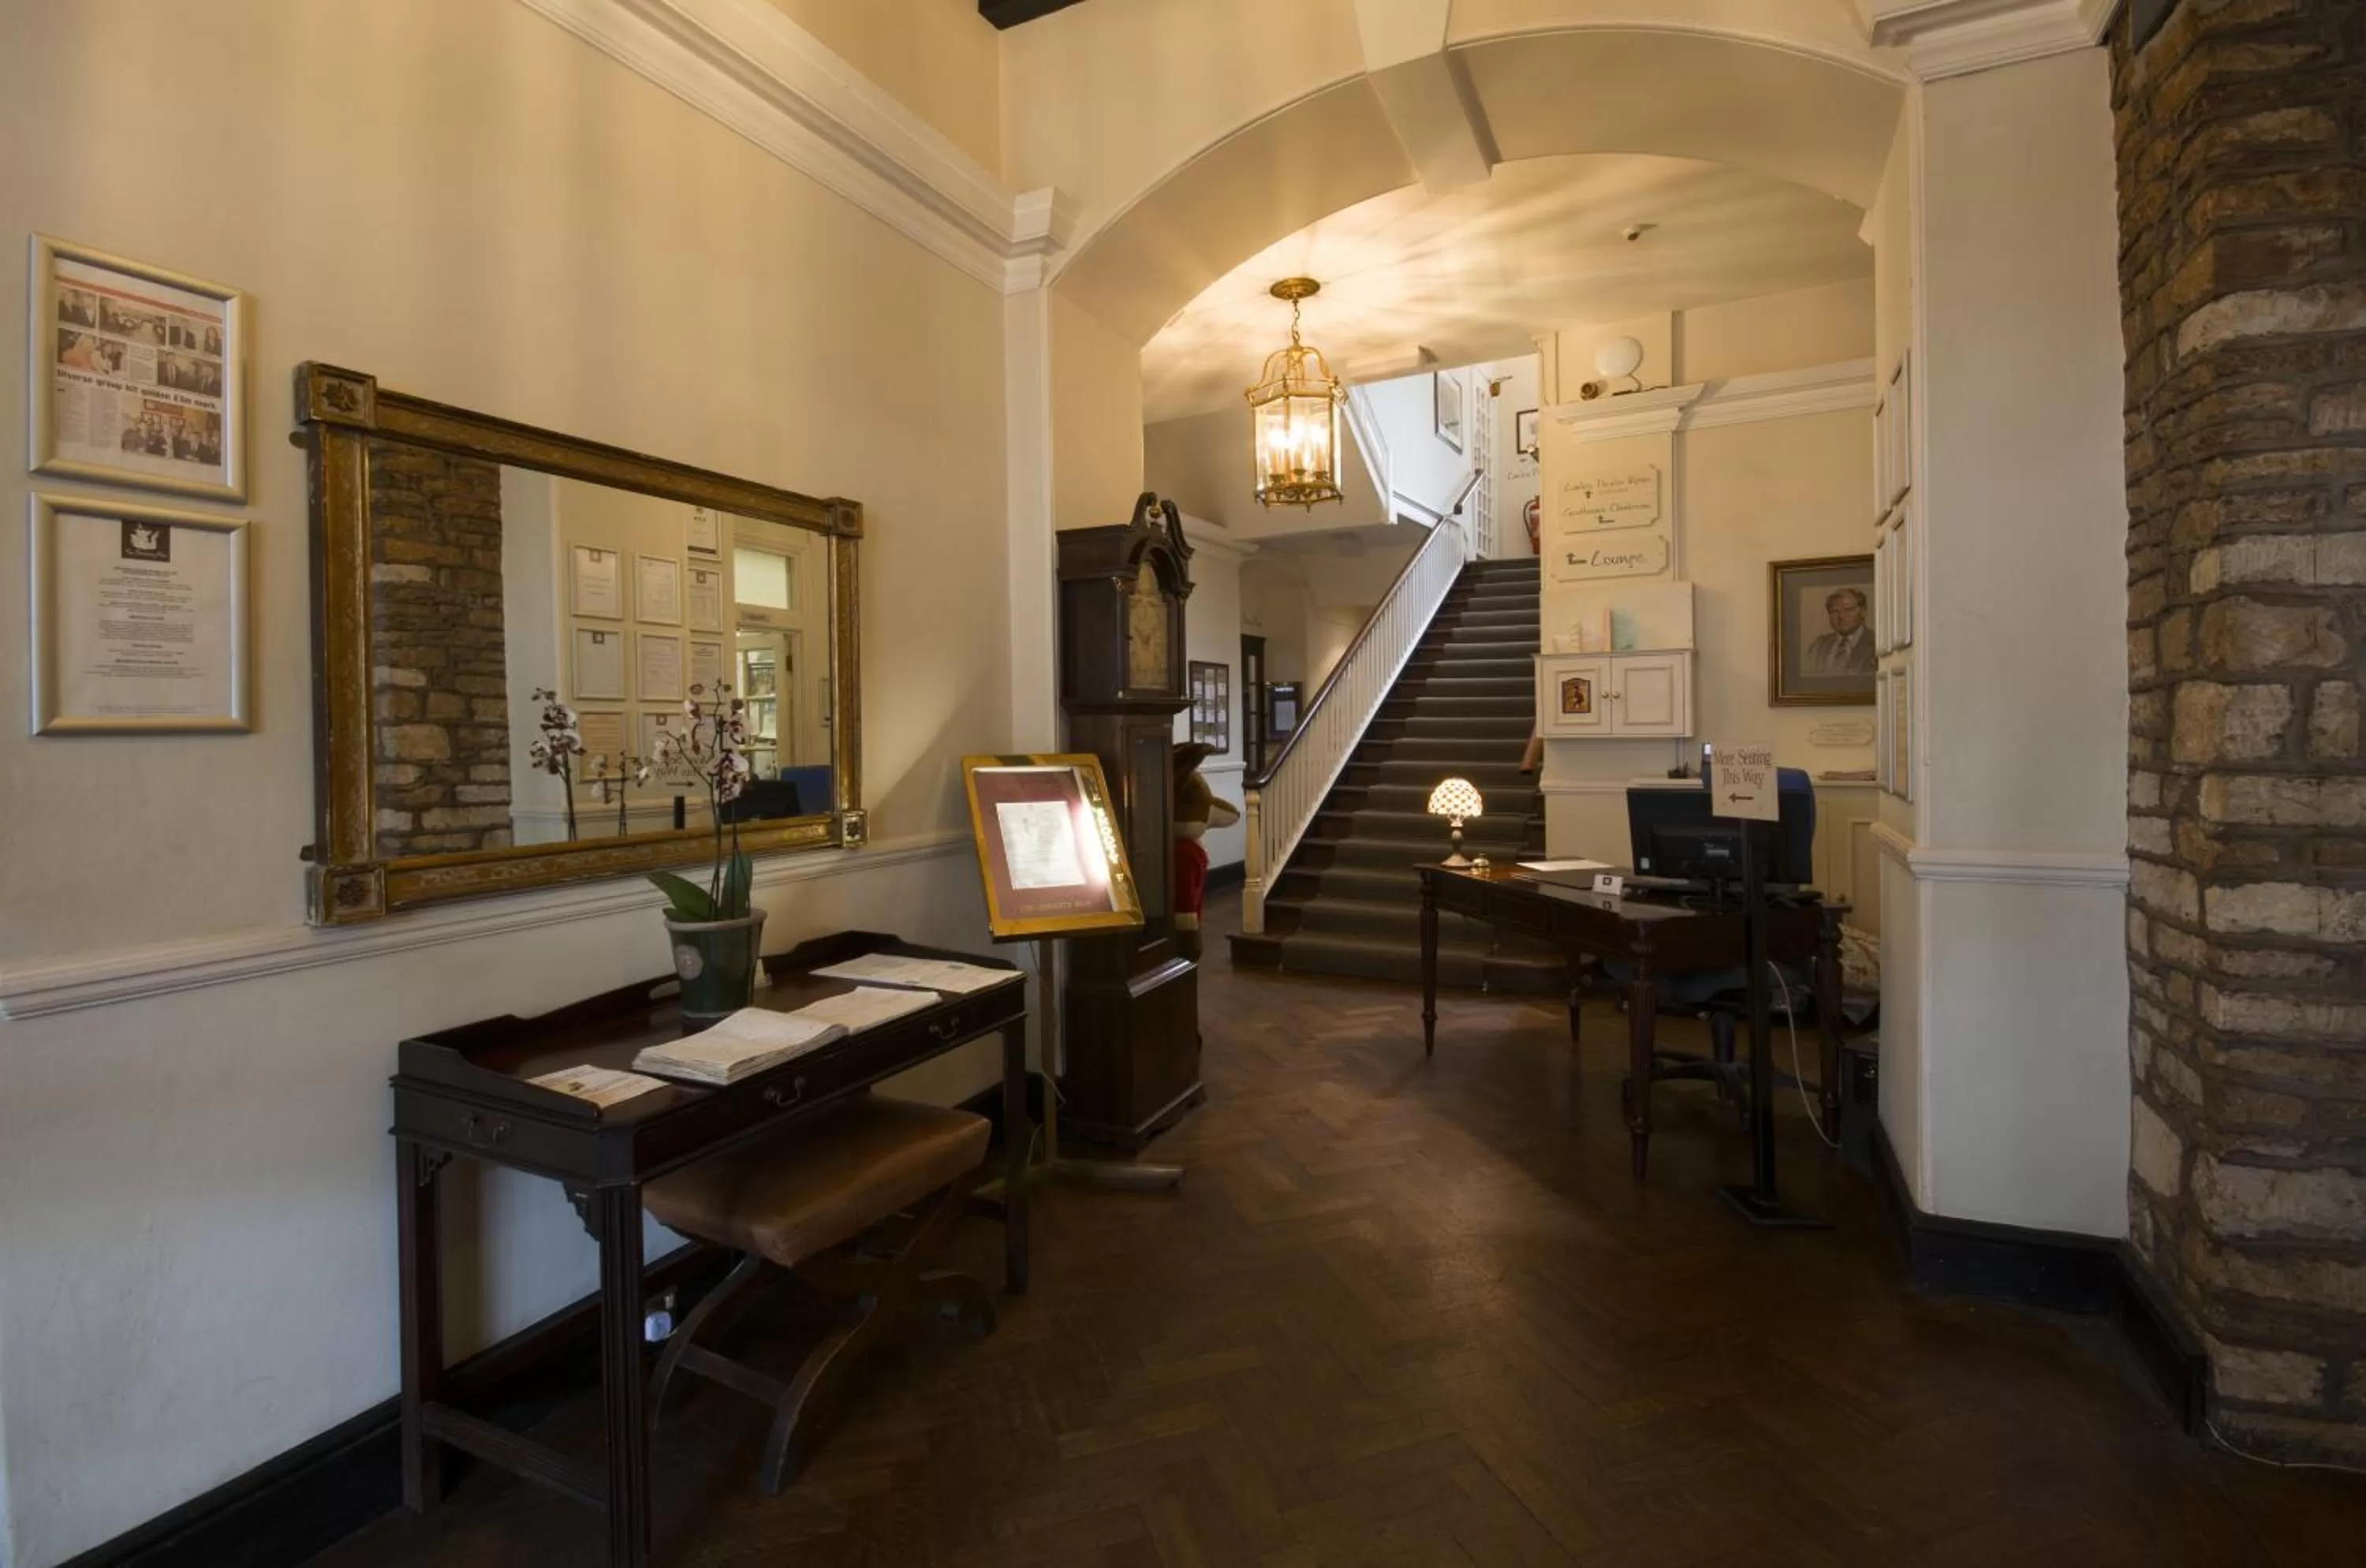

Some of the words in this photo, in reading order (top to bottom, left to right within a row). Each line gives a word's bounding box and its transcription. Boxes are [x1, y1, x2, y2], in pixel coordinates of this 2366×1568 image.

[1591, 550, 1645, 569] Lounge
[1713, 750, 1734, 765] More
[1737, 749, 1772, 768] Seating
[1720, 767, 1740, 785] This
[1741, 767, 1764, 790] Way
